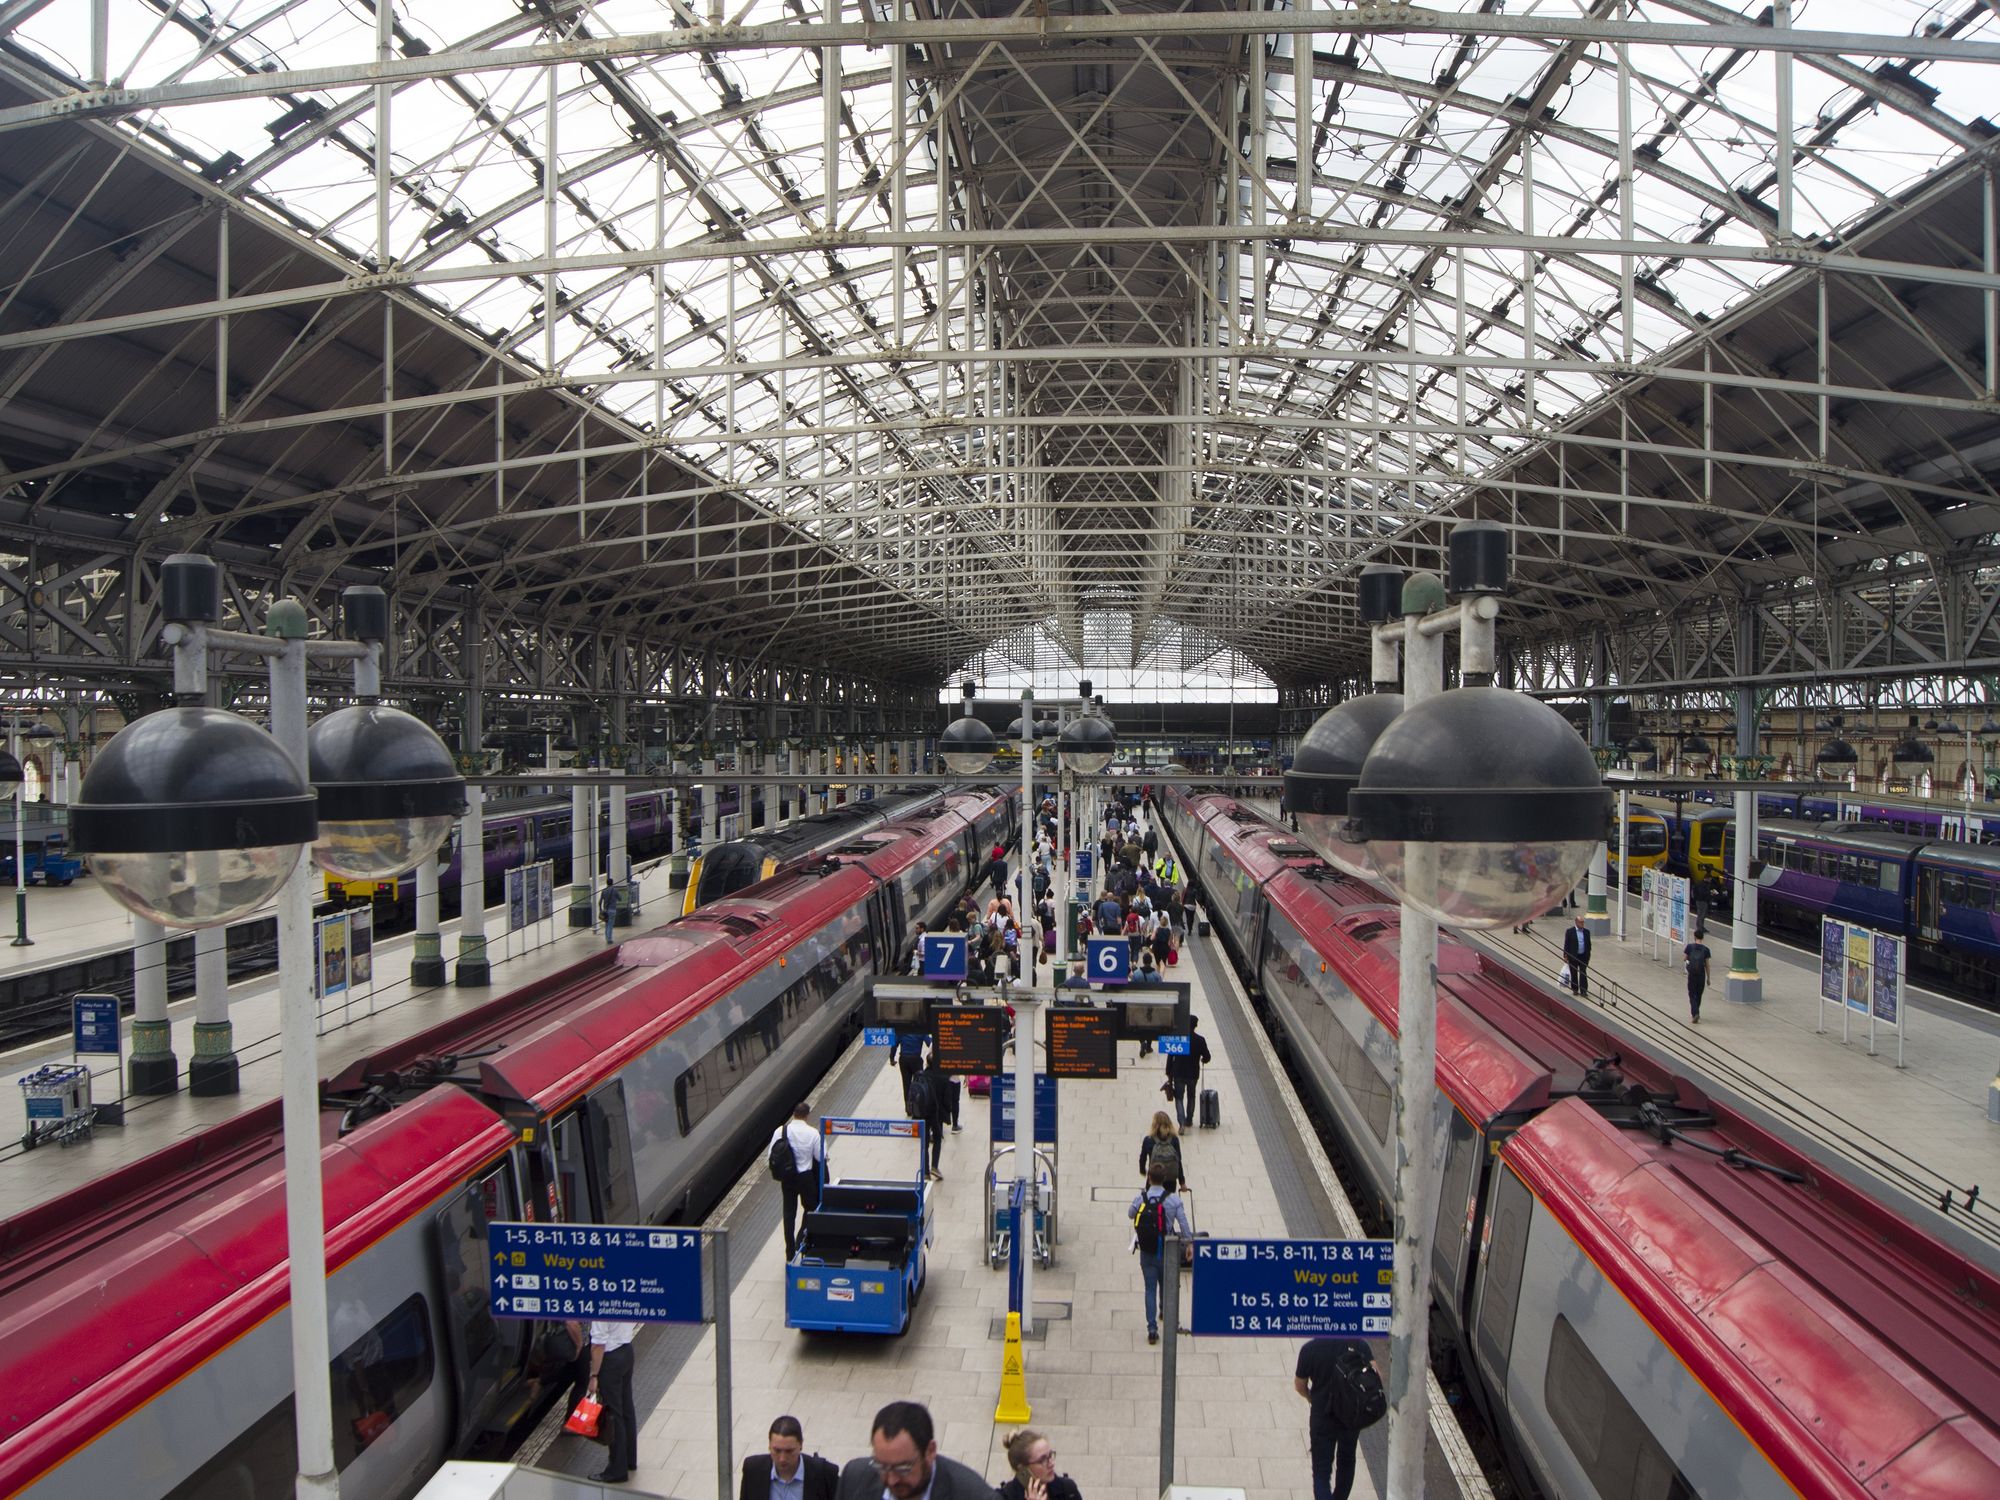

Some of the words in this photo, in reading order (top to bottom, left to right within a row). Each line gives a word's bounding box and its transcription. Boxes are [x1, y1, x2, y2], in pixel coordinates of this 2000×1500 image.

[936, 943, 954, 968] 7
[1098, 946, 1118, 972] 6
[871, 1035, 889, 1044] 368
[1165, 1043, 1183, 1053] 366
[858, 1122, 886, 1130] mobility
[571, 1232, 585, 1245] 13
[590, 1233, 601, 1246] &
[605, 1233, 621, 1246] 14
[1322, 1246, 1337, 1259] 13
[1342, 1247, 1353, 1260] &
[1358, 1247, 1374, 1260] 14
[543, 1254, 574, 1270] Way
[579, 1257, 605, 1268] out
[544, 1277, 550, 1289] 1
[554, 1278, 568, 1290] to
[572, 1278, 585, 1292] 5,
[589, 1278, 598, 1291] 8
[603, 1279, 617, 1292] to
[621, 1279, 636, 1292] 12
[1294, 1270, 1327, 1286] Way
[1331, 1272, 1359, 1283] out
[544, 1299, 560, 1312] 13
[563, 1300, 575, 1313] &
[579, 1301, 594, 1313] 14
[1232, 1293, 1237, 1306] 1
[1241, 1294, 1256, 1306] to
[1261, 1293, 1274, 1308] 5,
[1279, 1293, 1289, 1307] 8
[1293, 1294, 1308, 1307] to
[1313, 1293, 1328, 1307] 12
[599, 1307, 632, 1315] platforms
[1229, 1316, 1244, 1329] 13
[1249, 1316, 1261, 1330] &
[1266, 1316, 1281, 1330] 14
[1300, 1315, 1310, 1323] lift
[1312, 1315, 1331, 1323] from
[1287, 1323, 1322, 1331] platforms
